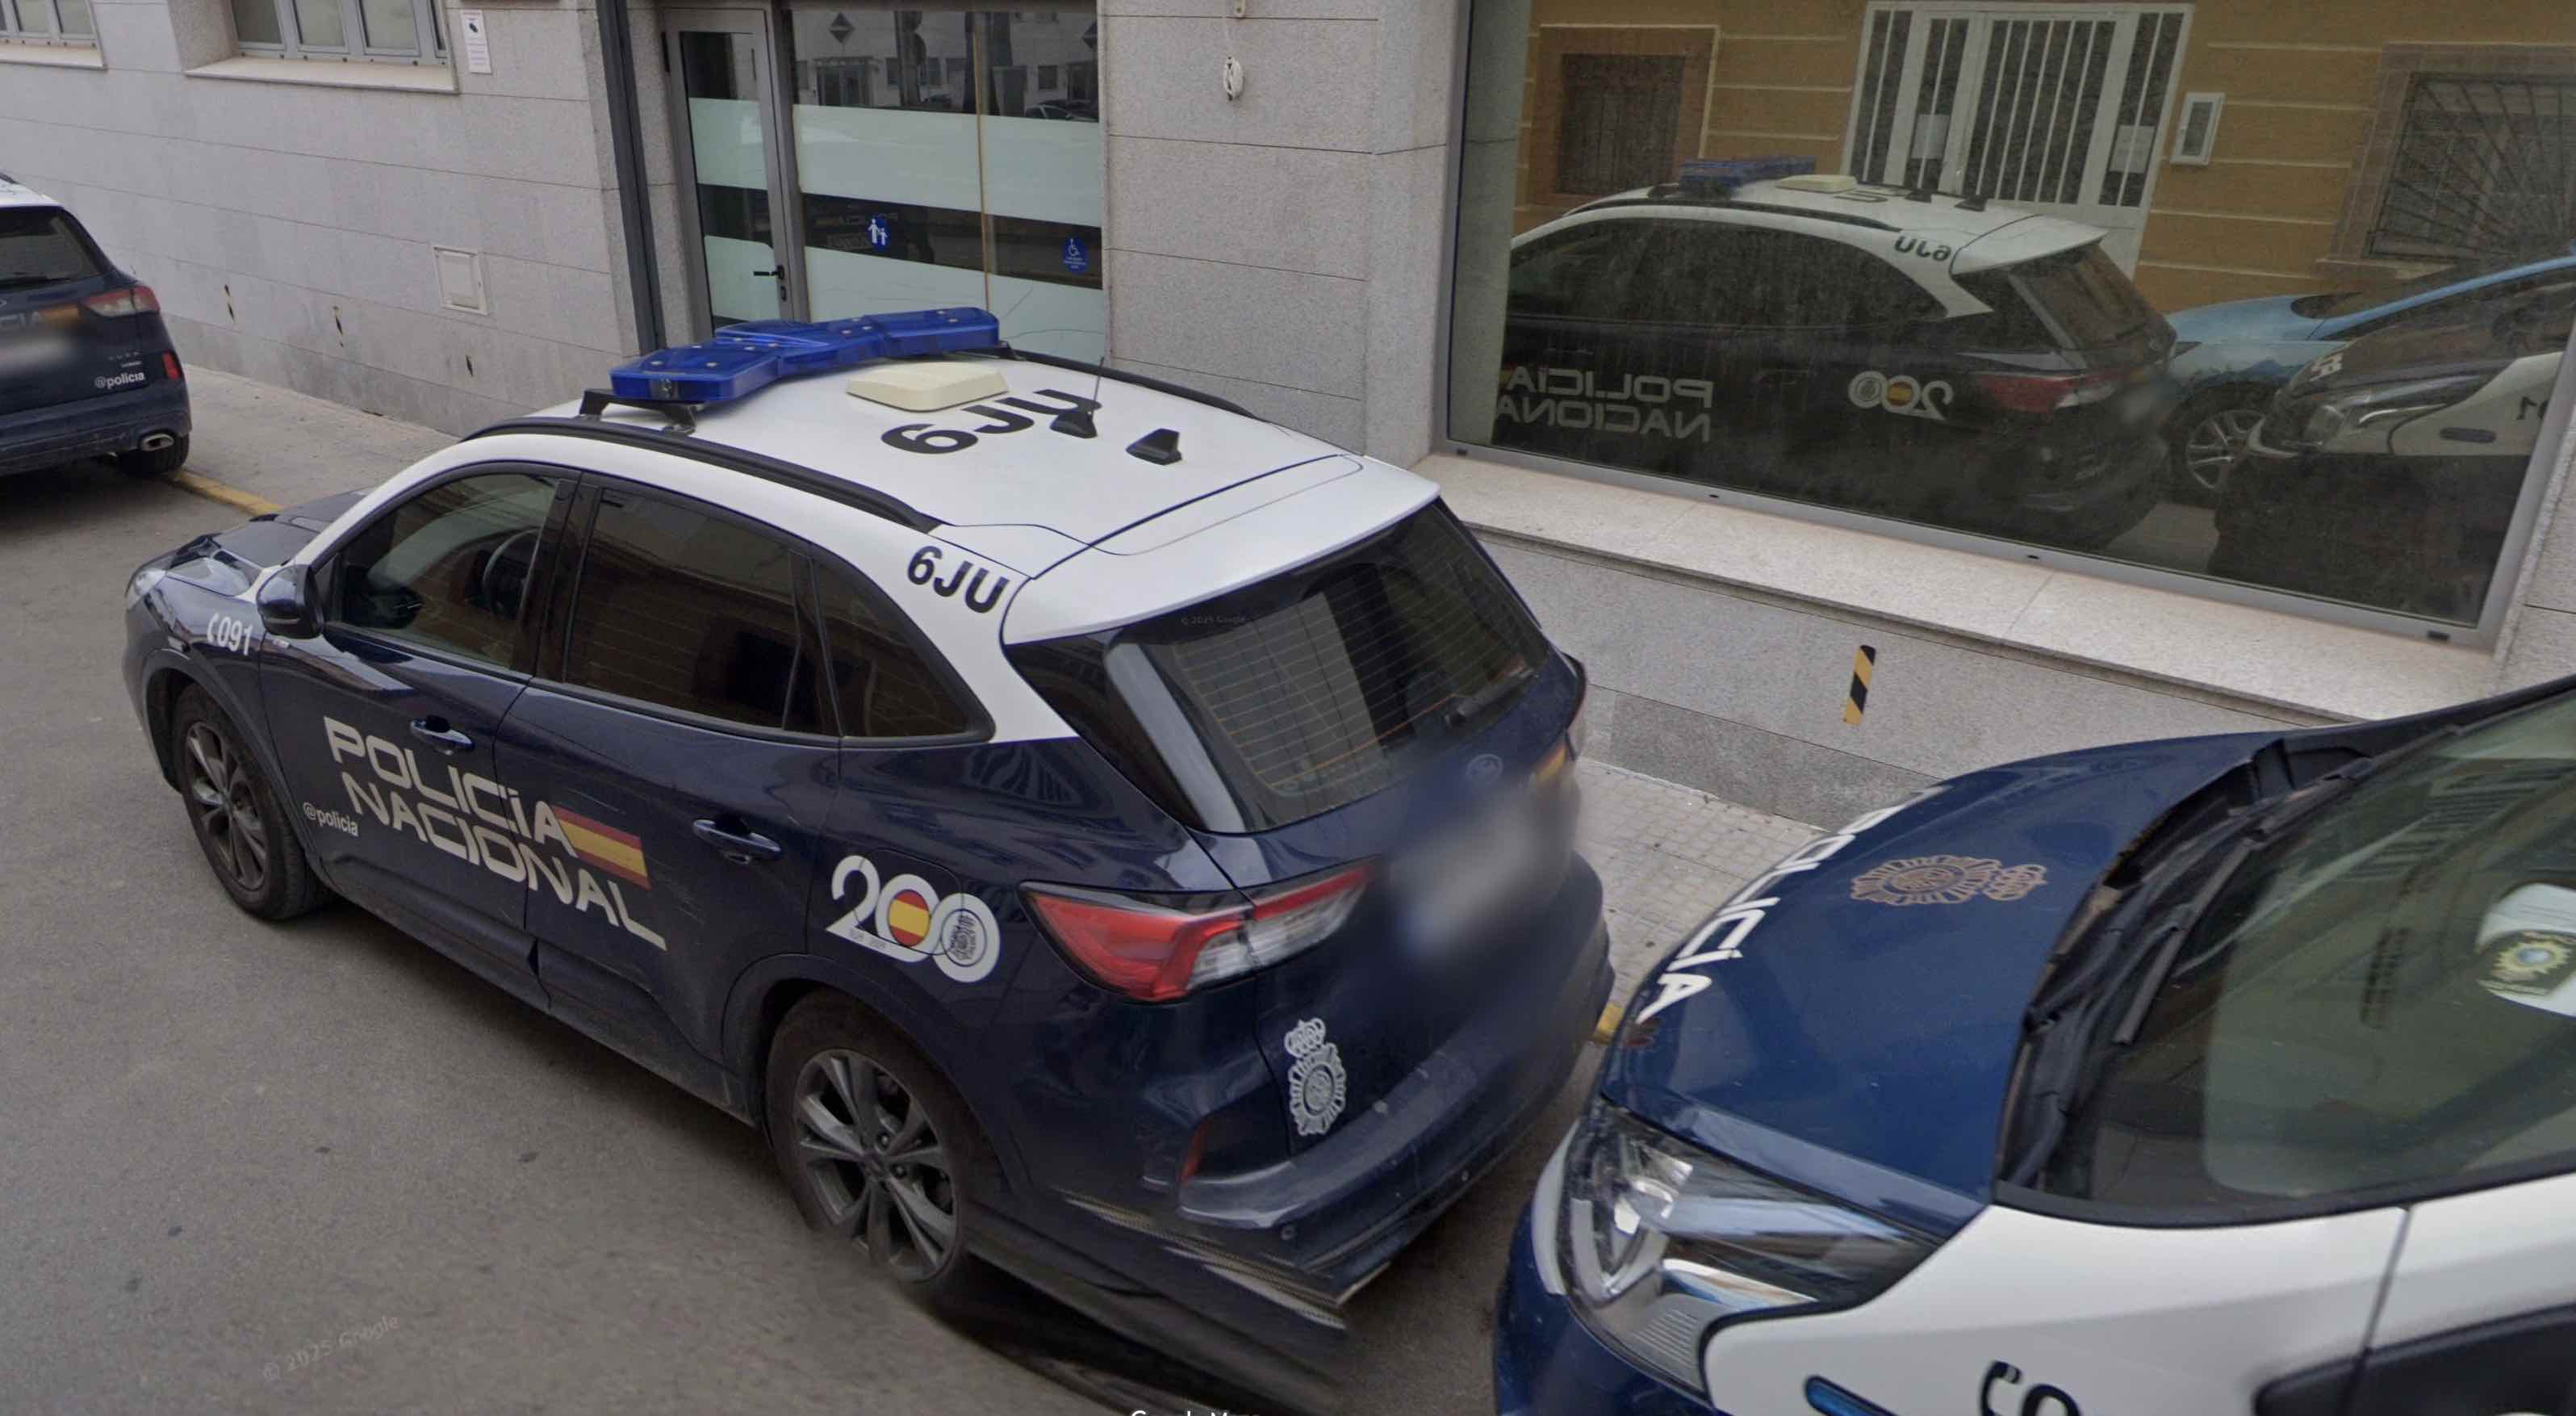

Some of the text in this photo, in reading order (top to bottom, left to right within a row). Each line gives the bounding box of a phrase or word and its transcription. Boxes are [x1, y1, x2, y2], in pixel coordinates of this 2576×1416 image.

[94, 371, 145, 389] @policia
[880, 388, 1102, 455] 6JU
[907, 545, 1010, 614] 6JU
[303, 801, 359, 837] @policia
[341, 771, 668, 951] NACIONAL
[826, 854, 1001, 983] 200
